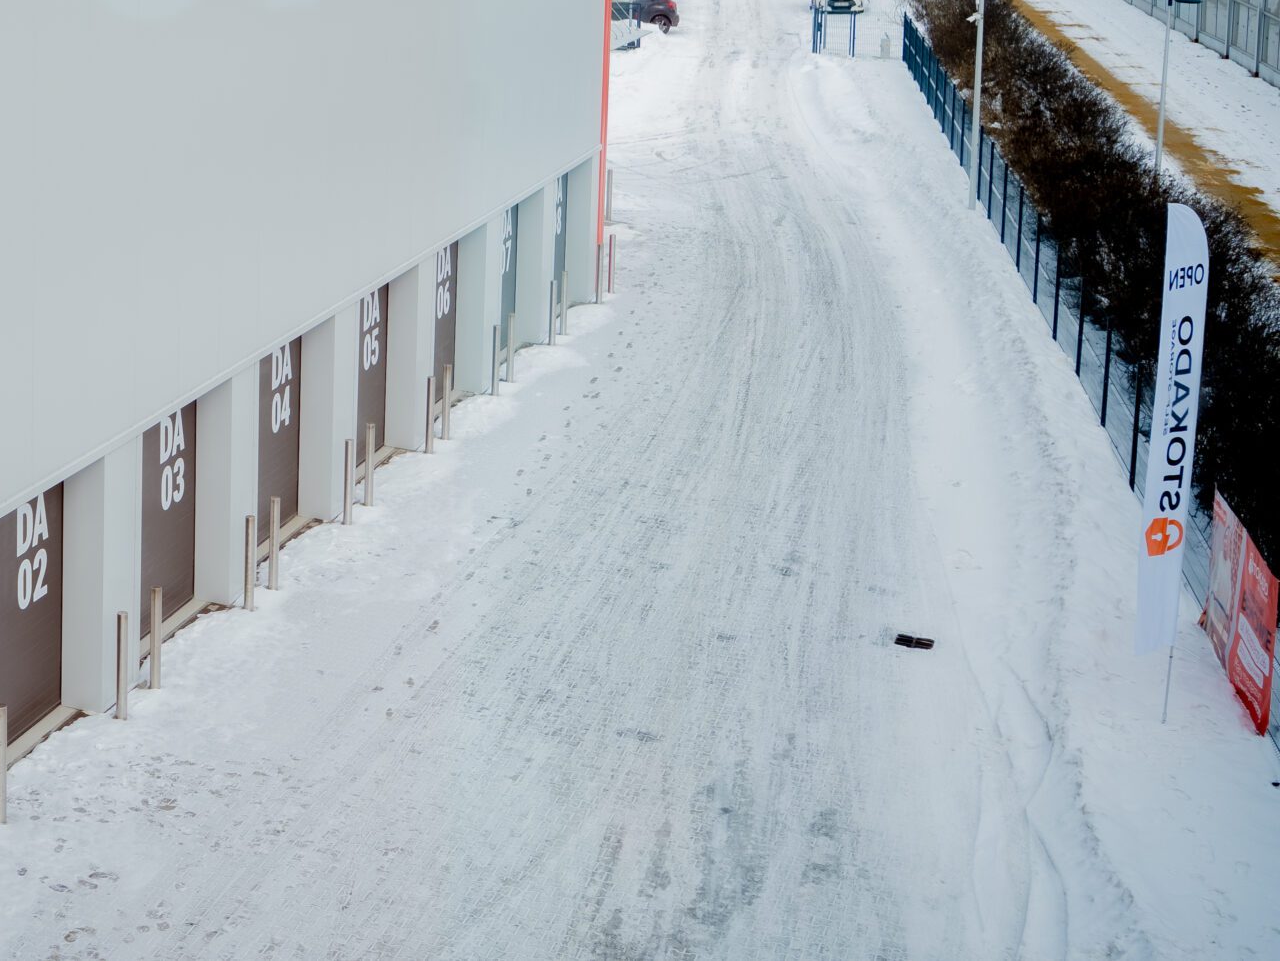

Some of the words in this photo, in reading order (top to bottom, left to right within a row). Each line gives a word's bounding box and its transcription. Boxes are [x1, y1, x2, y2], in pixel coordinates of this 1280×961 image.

[437, 245, 451, 283] DA
[363, 288, 380, 332] DA
[437, 280, 451, 319] 06
[271, 342, 292, 391] DA
[363, 326, 379, 371] 05
[271, 385, 291, 434] 04
[159, 408, 185, 465] DA
[160, 457, 186, 511] 03
[16, 492, 49, 558] DA
[17, 548, 49, 611] 02
